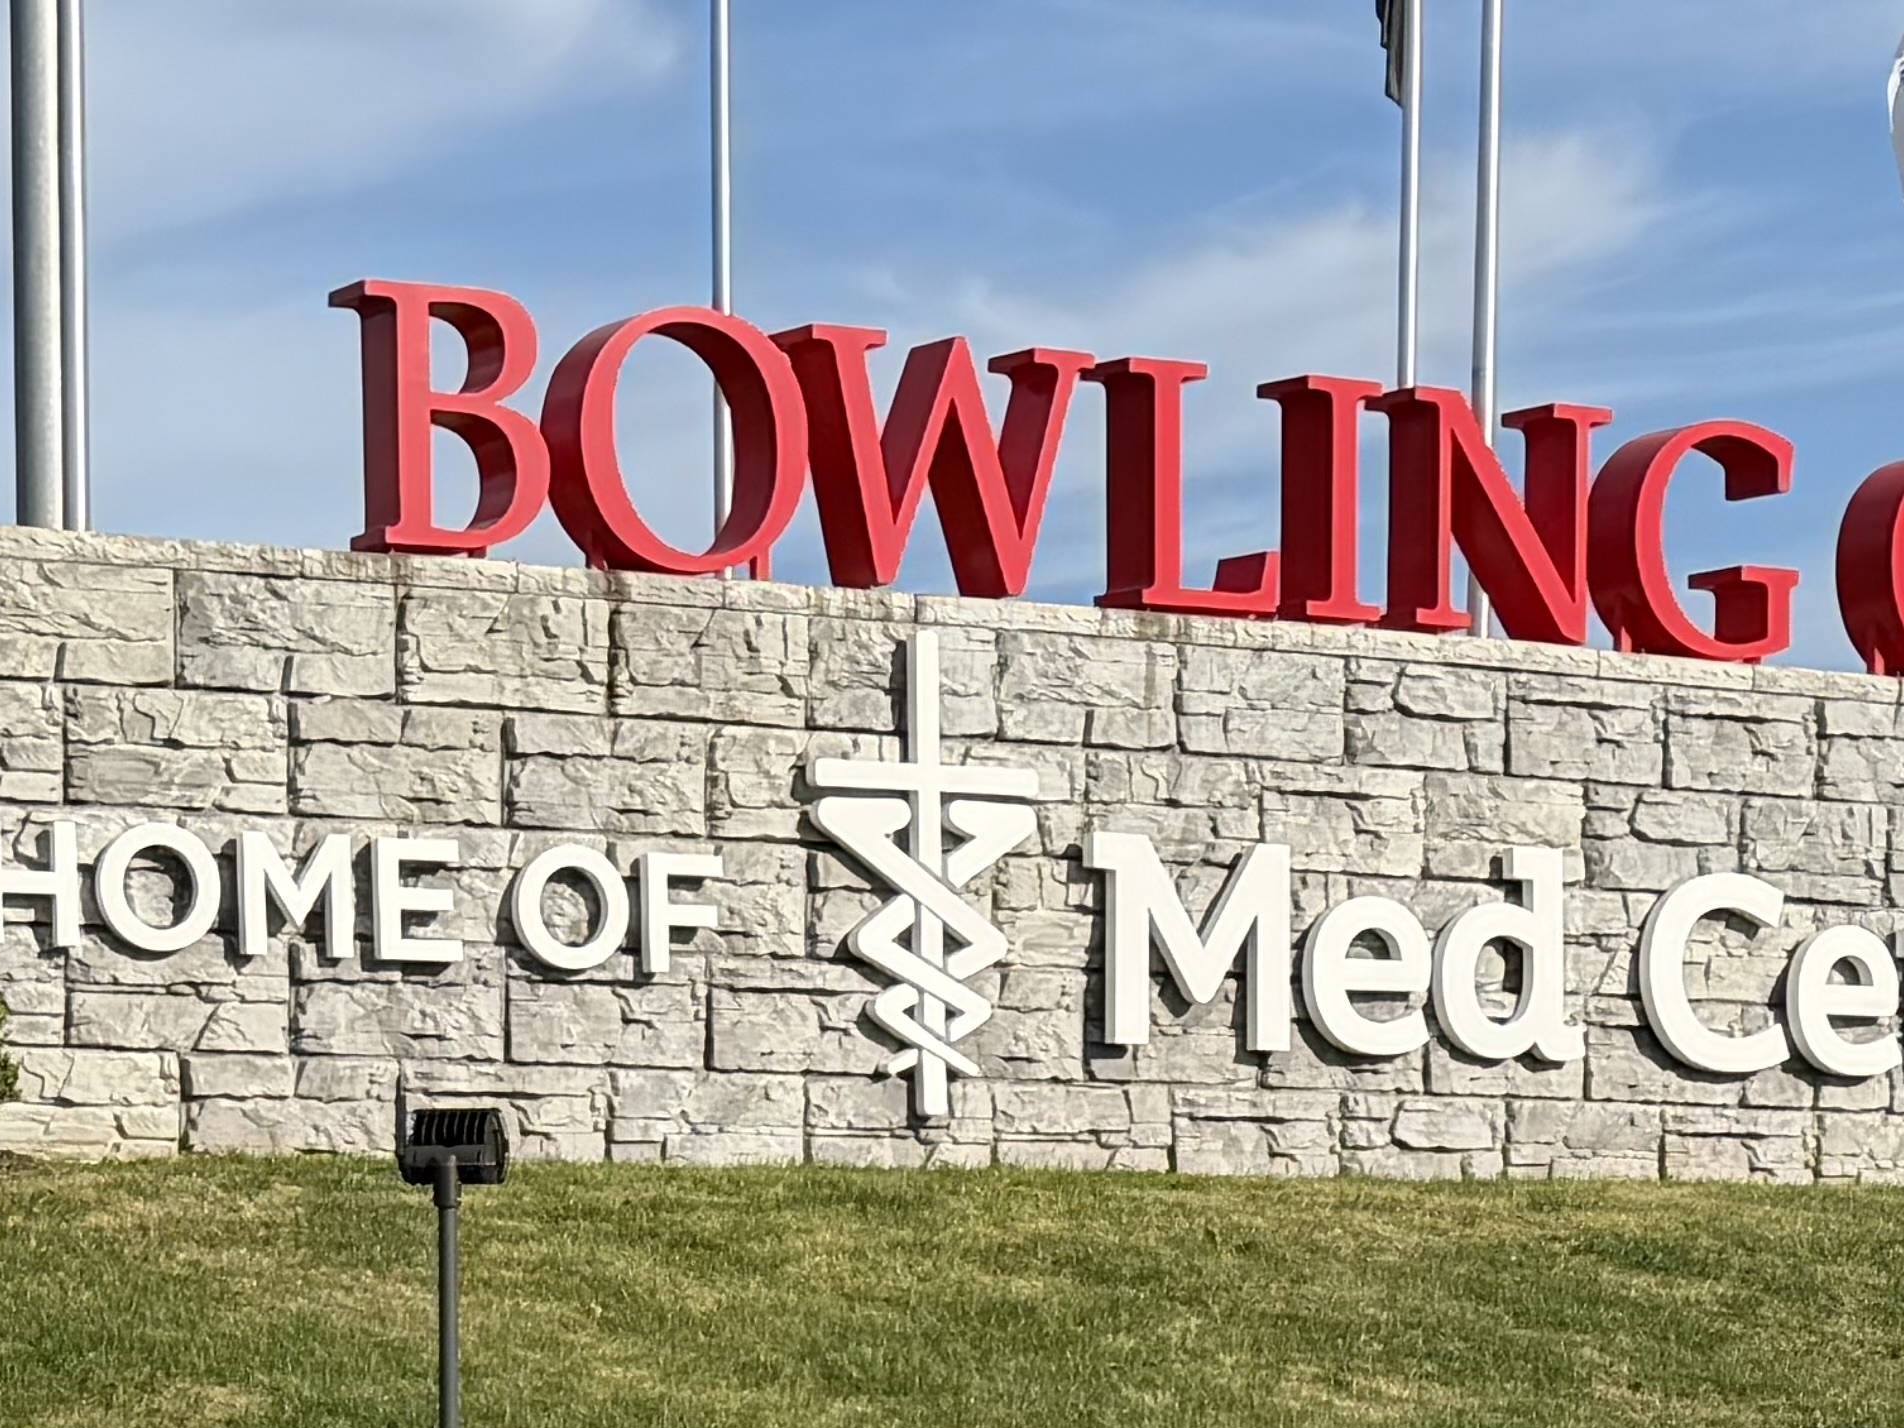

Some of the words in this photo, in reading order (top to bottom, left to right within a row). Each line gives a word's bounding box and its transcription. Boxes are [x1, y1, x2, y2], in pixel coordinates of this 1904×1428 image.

[328, 279, 1800, 664] BOWLING
[511, 843, 723, 973] OF
[1082, 831, 1587, 1061] Med
